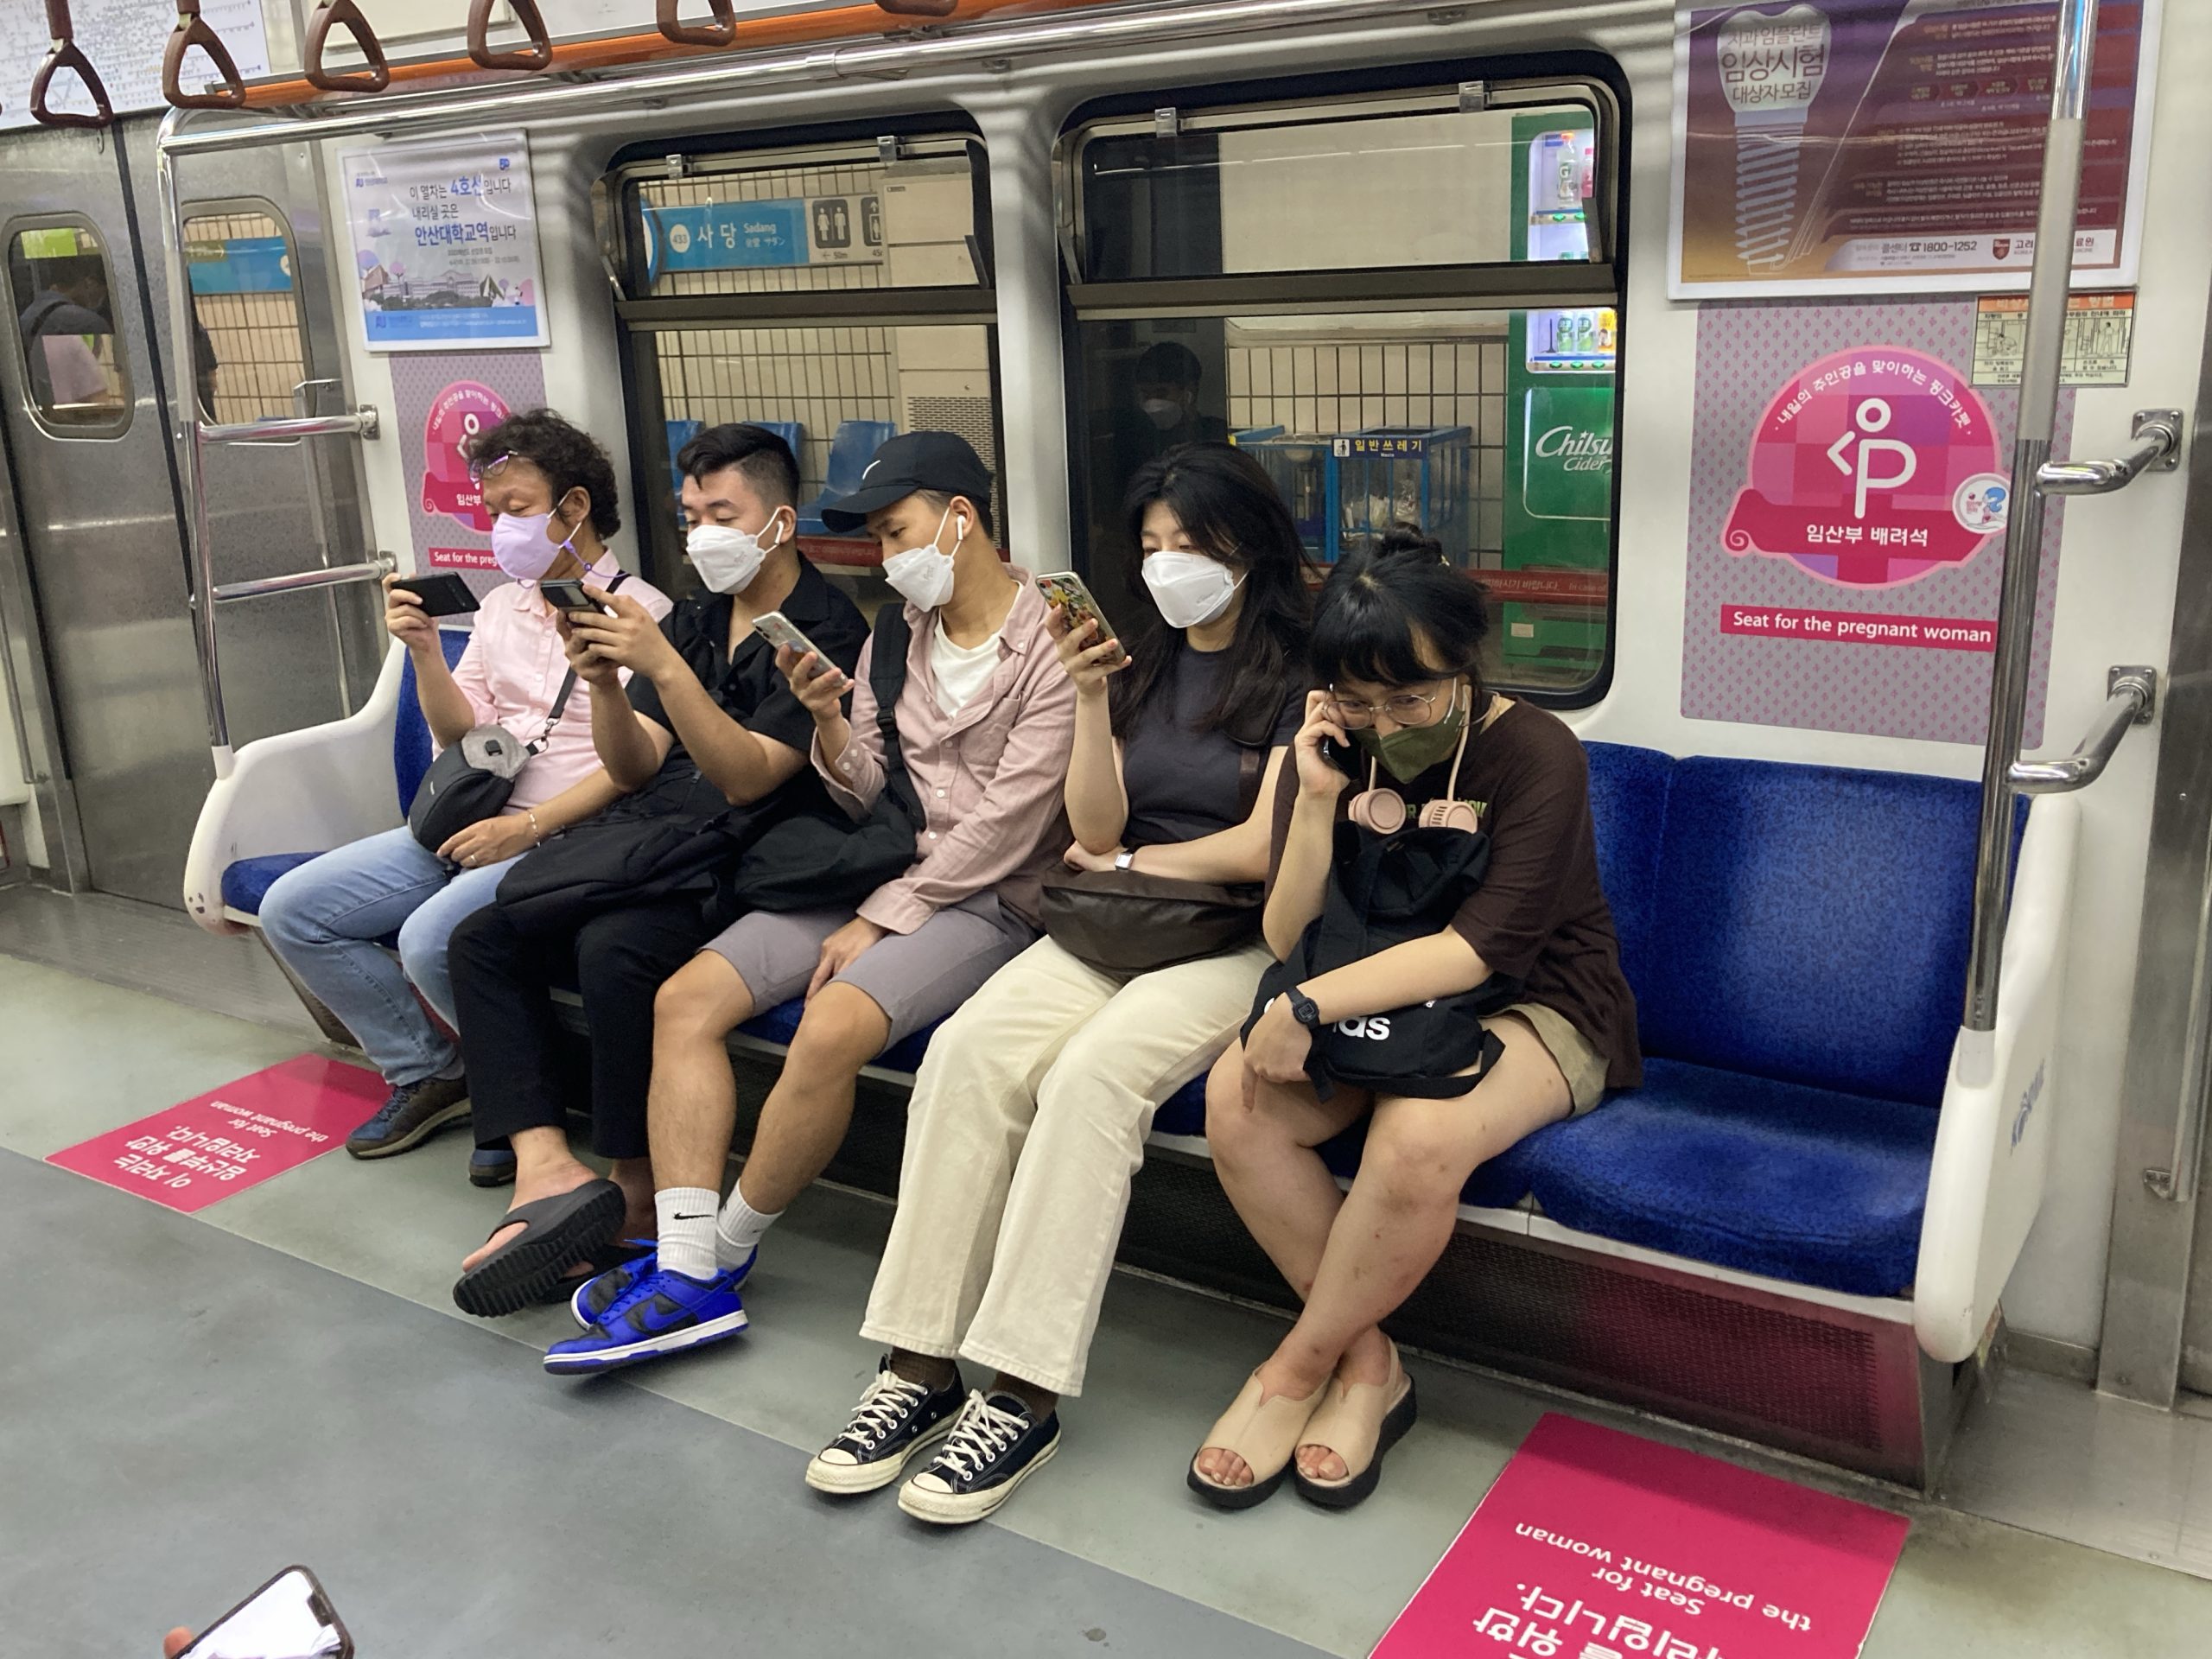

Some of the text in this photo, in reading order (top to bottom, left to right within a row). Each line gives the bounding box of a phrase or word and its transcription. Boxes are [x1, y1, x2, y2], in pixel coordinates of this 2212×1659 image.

[1721, 44, 1825, 83] 임상시험
[1733, 80, 1811, 104] 대상자 모집
[410, 186, 419, 200] 이
[421, 183, 448, 200] 열차는
[412, 204, 459, 221] 내리실 곳은
[696, 223, 737, 249] 사당
[743, 222, 776, 234] Sadang
[1923, 240, 1977, 252] 1800-1252
[1777, 359, 1972, 429] 내일의 주인공을 맞이하는 핑크카펫
[1355, 439, 1421, 452] 일반쓰레기
[1535, 425, 1613, 458] Chilsu
[1563, 457, 1610, 472] Cider
[456, 493, 481, 506] 임산부
[1806, 524, 1929, 547] 임산부 배려석
[435, 551, 499, 567] Seat for the preg
[1733, 611, 1992, 643] Seat for the pregnant woman
[210, 1100, 329, 1143] the pregnant woman
[227, 1119, 278, 1139] Seat for
[113, 1153, 192, 1188] 이 자리는
[1515, 1522, 1812, 1632] the pregnant woman
[1592, 1567, 1706, 1616] Seat for
[1472, 1607, 1563, 1656] 위한
